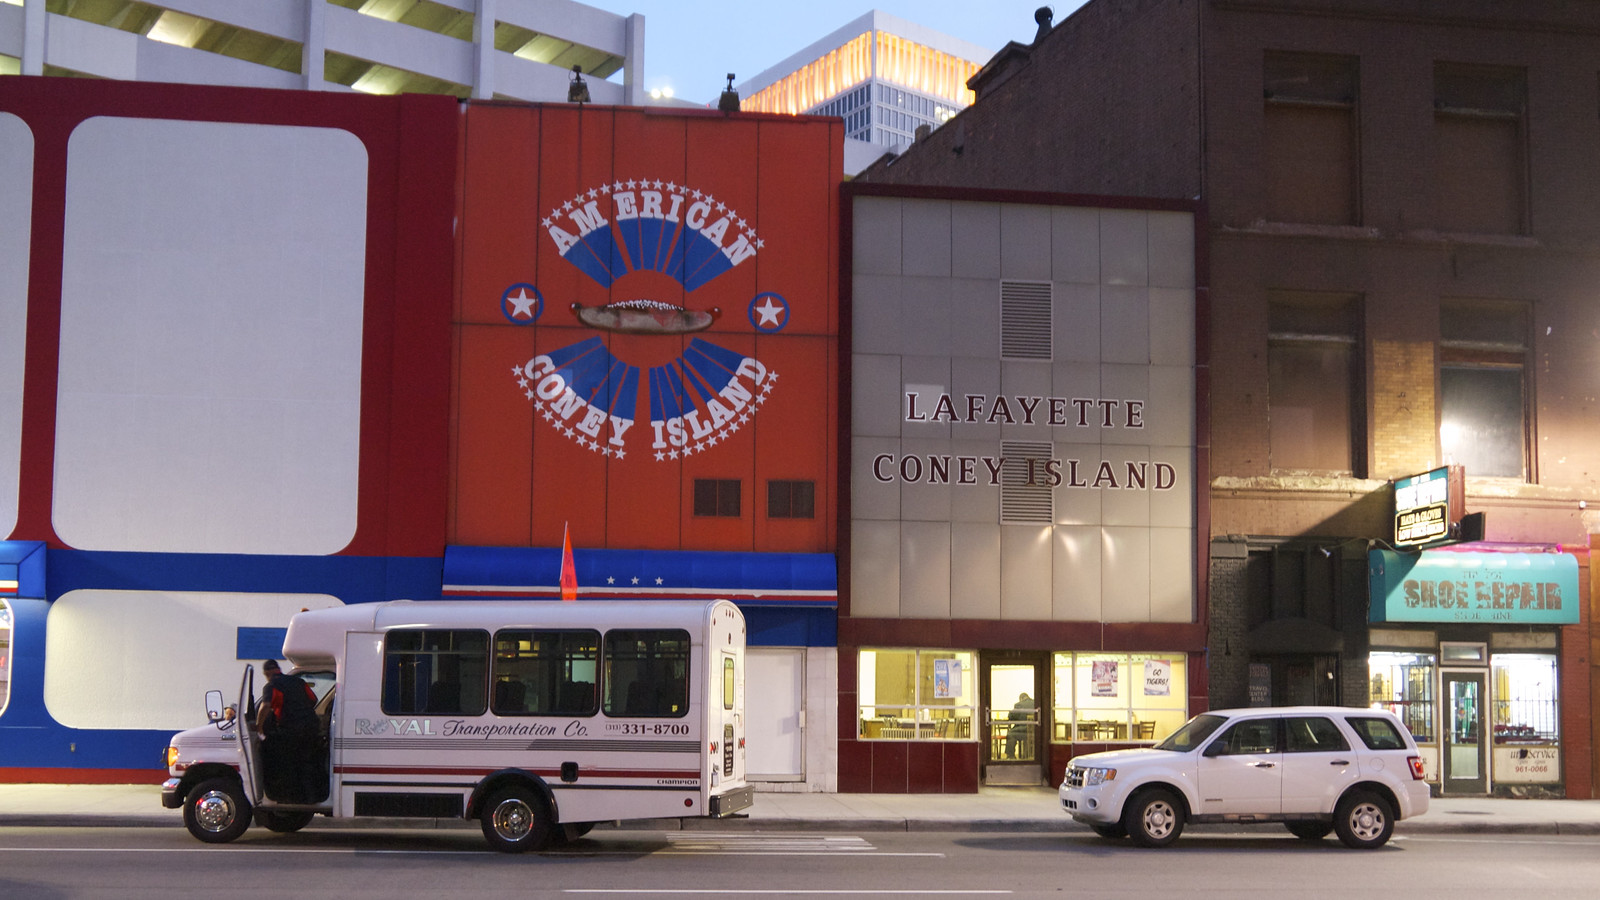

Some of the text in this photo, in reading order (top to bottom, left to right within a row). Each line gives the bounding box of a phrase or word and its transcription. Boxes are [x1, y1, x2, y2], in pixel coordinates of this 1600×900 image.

[548, 190, 757, 267] AMERICAN
[523, 354, 768, 449] CONEY ISLAND
[904, 391, 1145, 429] LAFAYETTE
[872, 454, 1178, 491] CONEY ISLAND
[1403, 579, 1562, 610] SHOE REPAIR
[1146, 678, 1169, 686] TIGERS!
[1152, 668, 1162, 677] GO
[442, 719, 557, 740] Transportation
[563, 720, 589, 737] Co.
[621, 723, 690, 735] 331-8700
